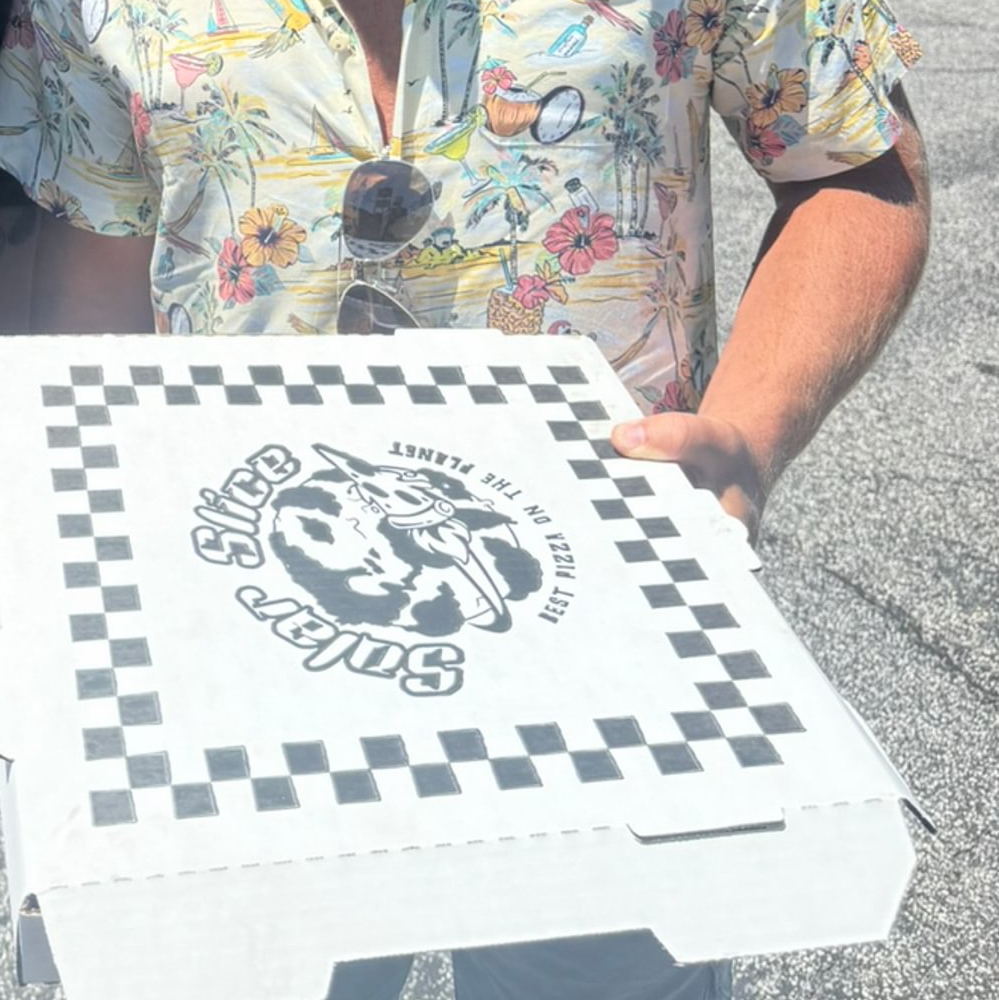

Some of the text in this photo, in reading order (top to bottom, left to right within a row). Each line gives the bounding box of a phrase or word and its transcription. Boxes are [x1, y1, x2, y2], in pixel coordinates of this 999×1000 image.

[190, 444, 466, 696] Solar Slice
[388, 441, 577, 625] BEST PIZZA ON THE PLANET
